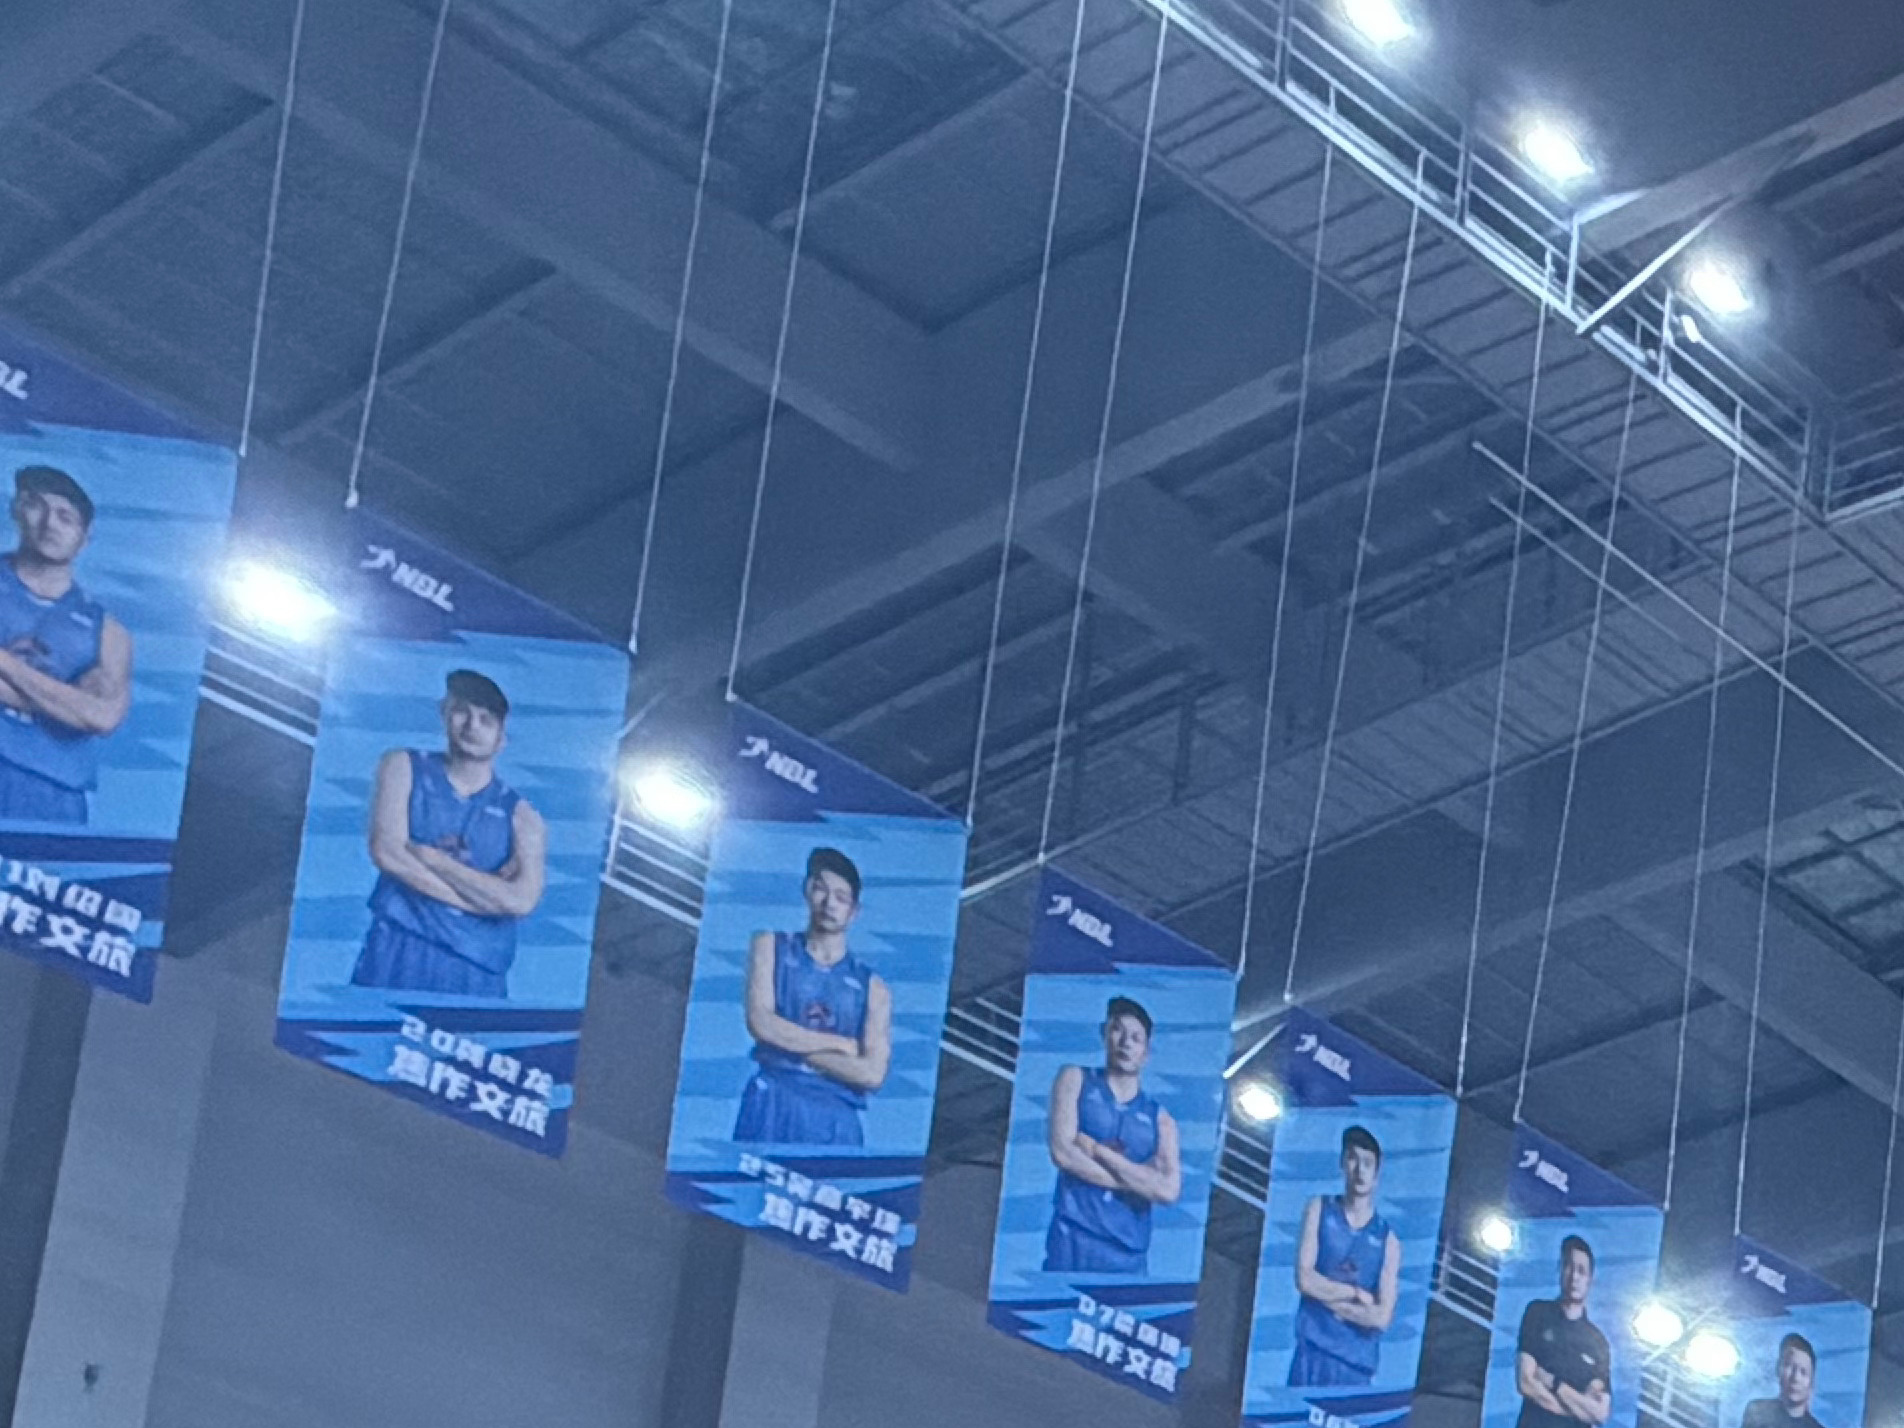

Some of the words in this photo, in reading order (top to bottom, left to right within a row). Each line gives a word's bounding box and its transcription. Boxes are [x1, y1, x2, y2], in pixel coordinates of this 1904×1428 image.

[0, 890, 136, 979] 作文旅
[387, 1045, 550, 1138] 焦作文旅
[759, 1192, 898, 1273] 焦作文旅
